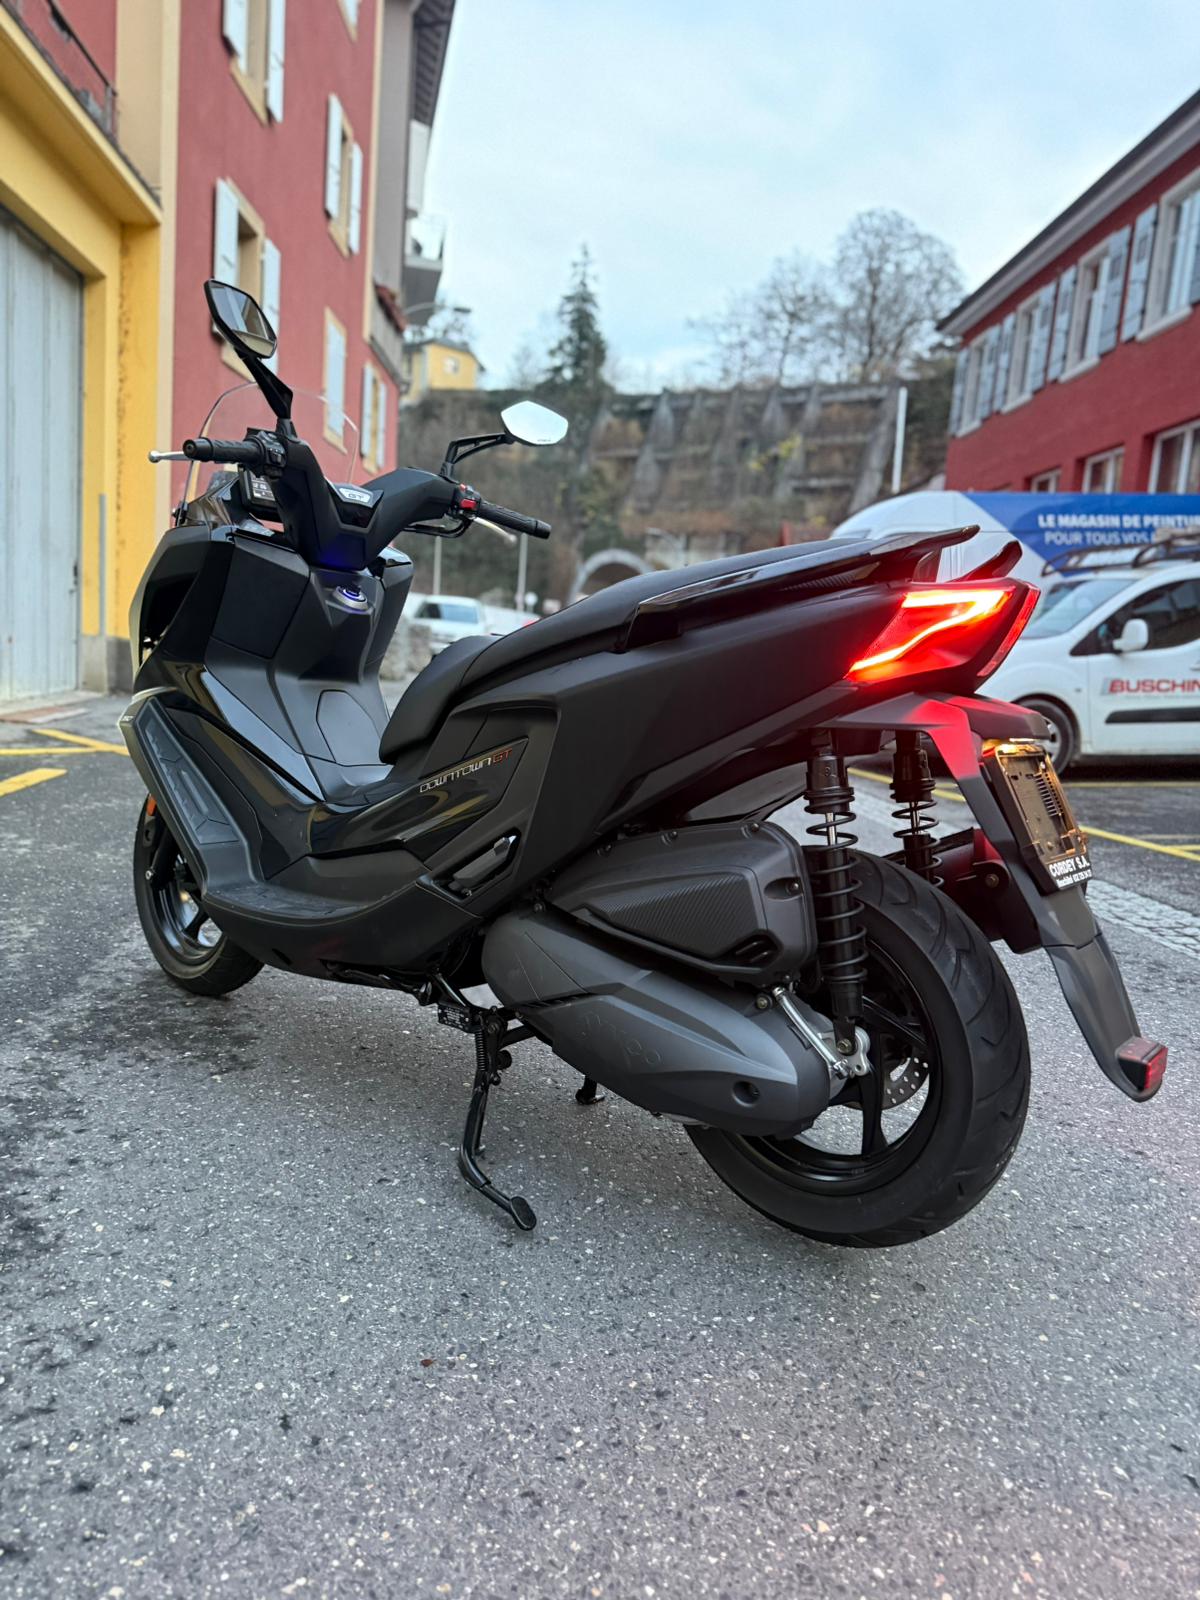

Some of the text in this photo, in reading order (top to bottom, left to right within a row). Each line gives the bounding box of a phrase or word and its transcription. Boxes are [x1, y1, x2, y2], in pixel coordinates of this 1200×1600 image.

[1037, 514, 1056, 528] LE
[1057, 514, 1120, 528] MAGASIN
[1122, 514, 1141, 528] DE
[1044, 531, 1082, 545] POUR
[1084, 531, 1120, 545] TOUS
